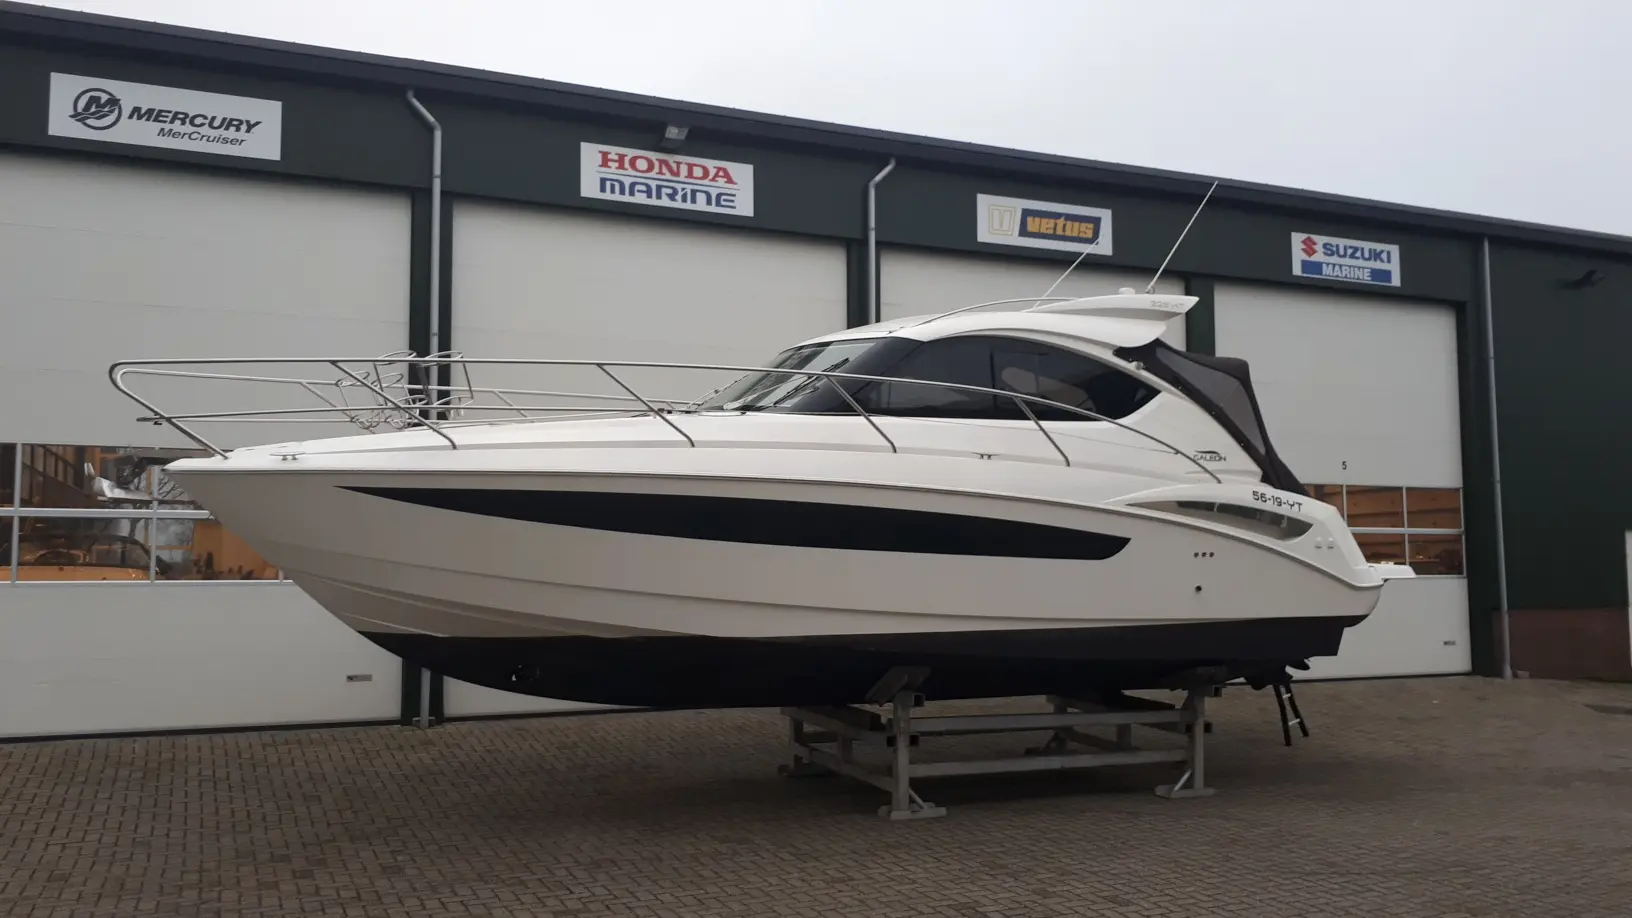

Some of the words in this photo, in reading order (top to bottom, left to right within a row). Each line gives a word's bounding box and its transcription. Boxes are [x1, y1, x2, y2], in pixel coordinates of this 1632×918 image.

[127, 106, 262, 133] MERCURY
[157, 128, 247, 146] MerCruiser
[598, 151, 737, 185] HONDA
[1027, 215, 1094, 238] vetus
[1322, 242, 1391, 264] SUZUKI
[1322, 263, 1371, 280] MARINE
[1341, 461, 1348, 470] 5
[1252, 490, 1303, 512] 56-19-YT
